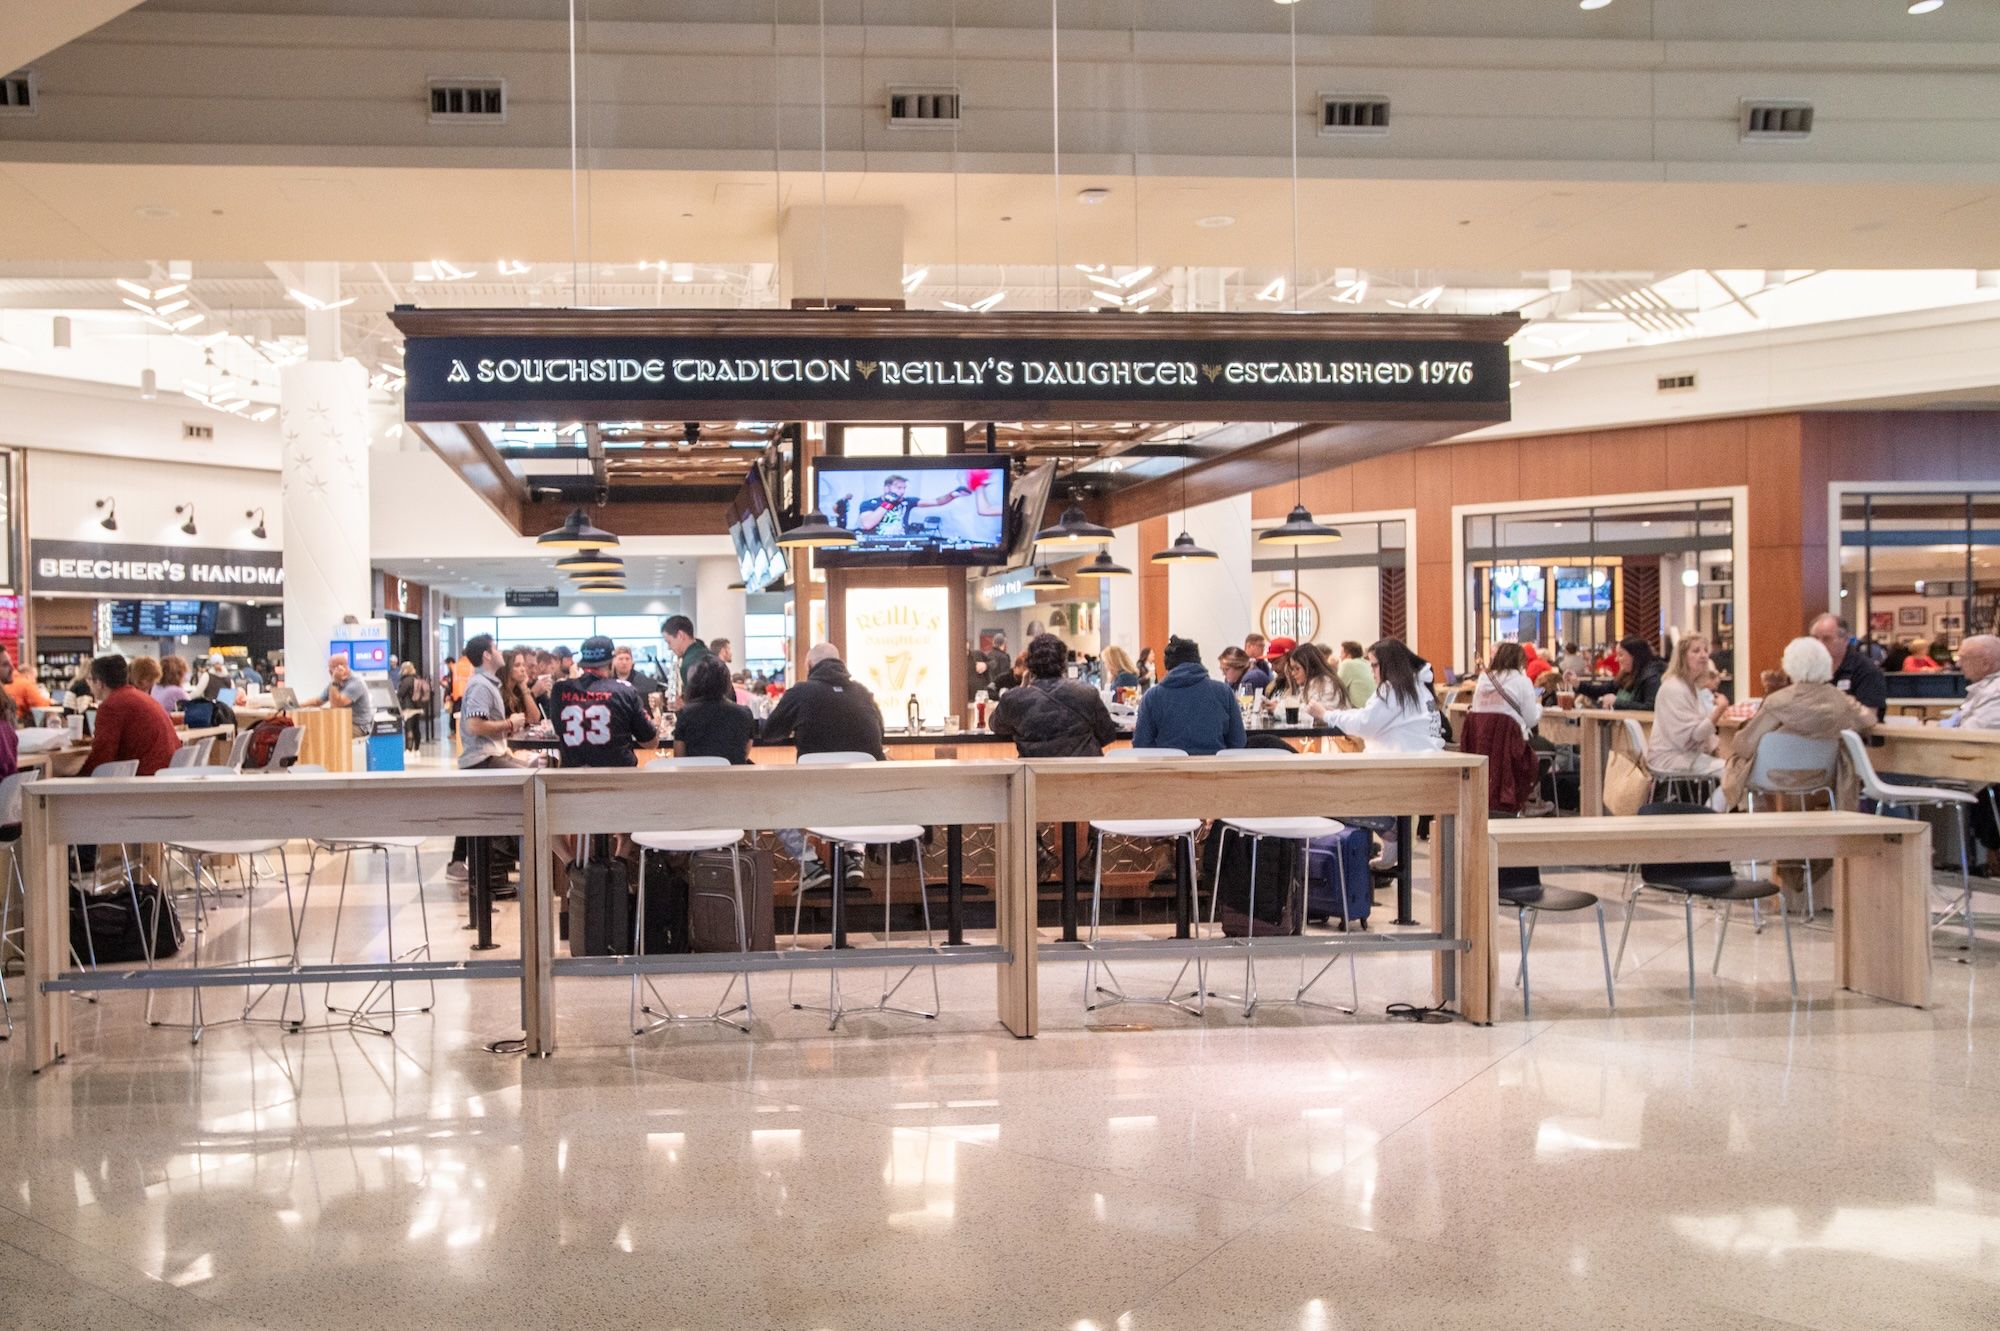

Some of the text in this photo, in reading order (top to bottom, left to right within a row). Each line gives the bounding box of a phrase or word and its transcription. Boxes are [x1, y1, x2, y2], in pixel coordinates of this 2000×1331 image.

[447, 357, 1474, 385] A SOUTHSIDE TRADITION REILLY'S DAUGHTER ESTABLISHED 1976
[39, 558, 185, 583] BEECHER'S
[561, 704, 611, 747] 33
